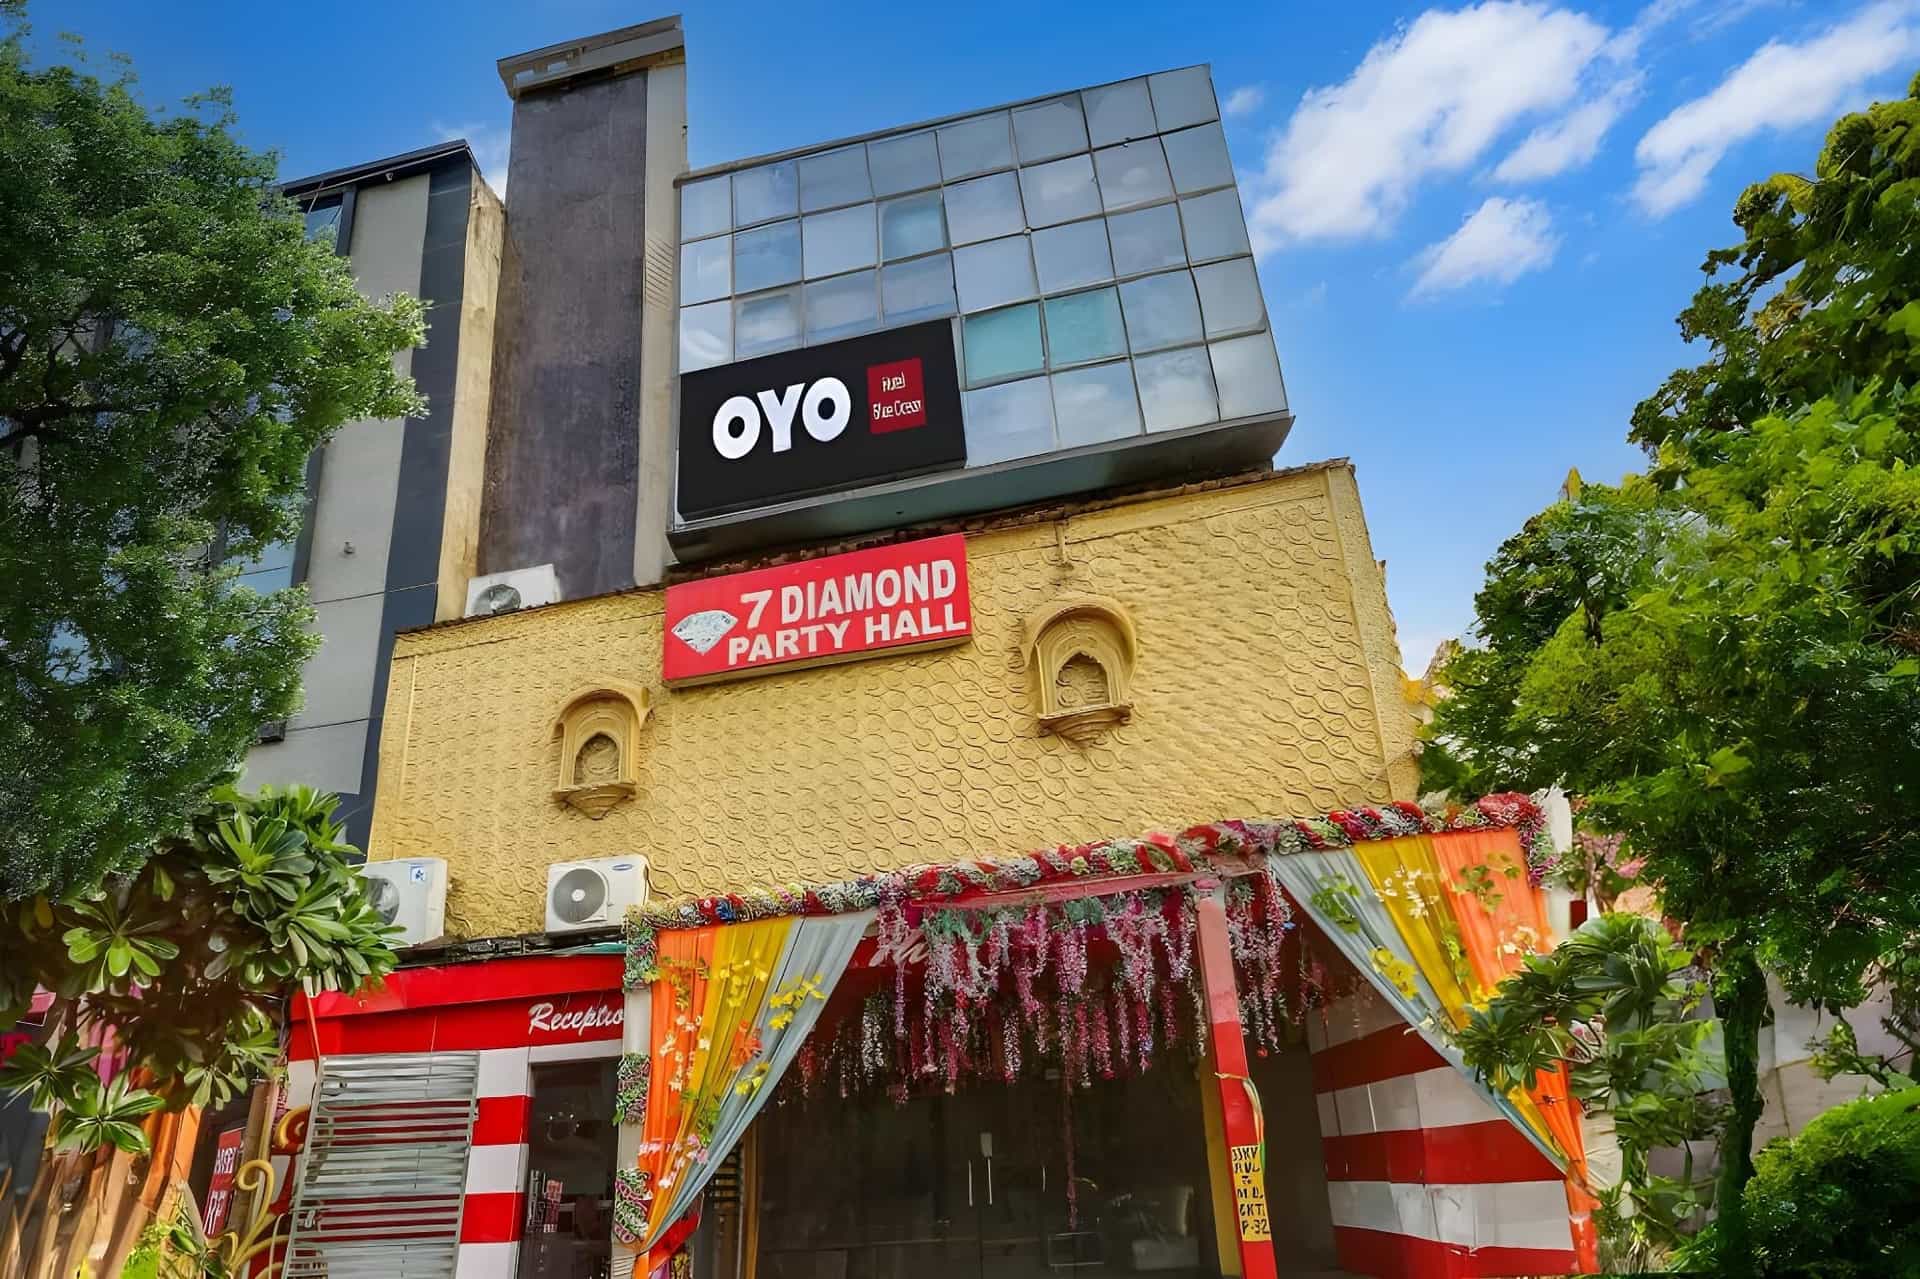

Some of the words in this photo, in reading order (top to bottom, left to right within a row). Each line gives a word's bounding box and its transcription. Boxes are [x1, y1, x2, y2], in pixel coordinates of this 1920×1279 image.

[712, 377, 851, 460] OYO
[740, 590, 772, 629] 7
[780, 559, 956, 625] DIAMOND
[728, 620, 849, 666] PARTY
[865, 603, 966, 645] HALL
